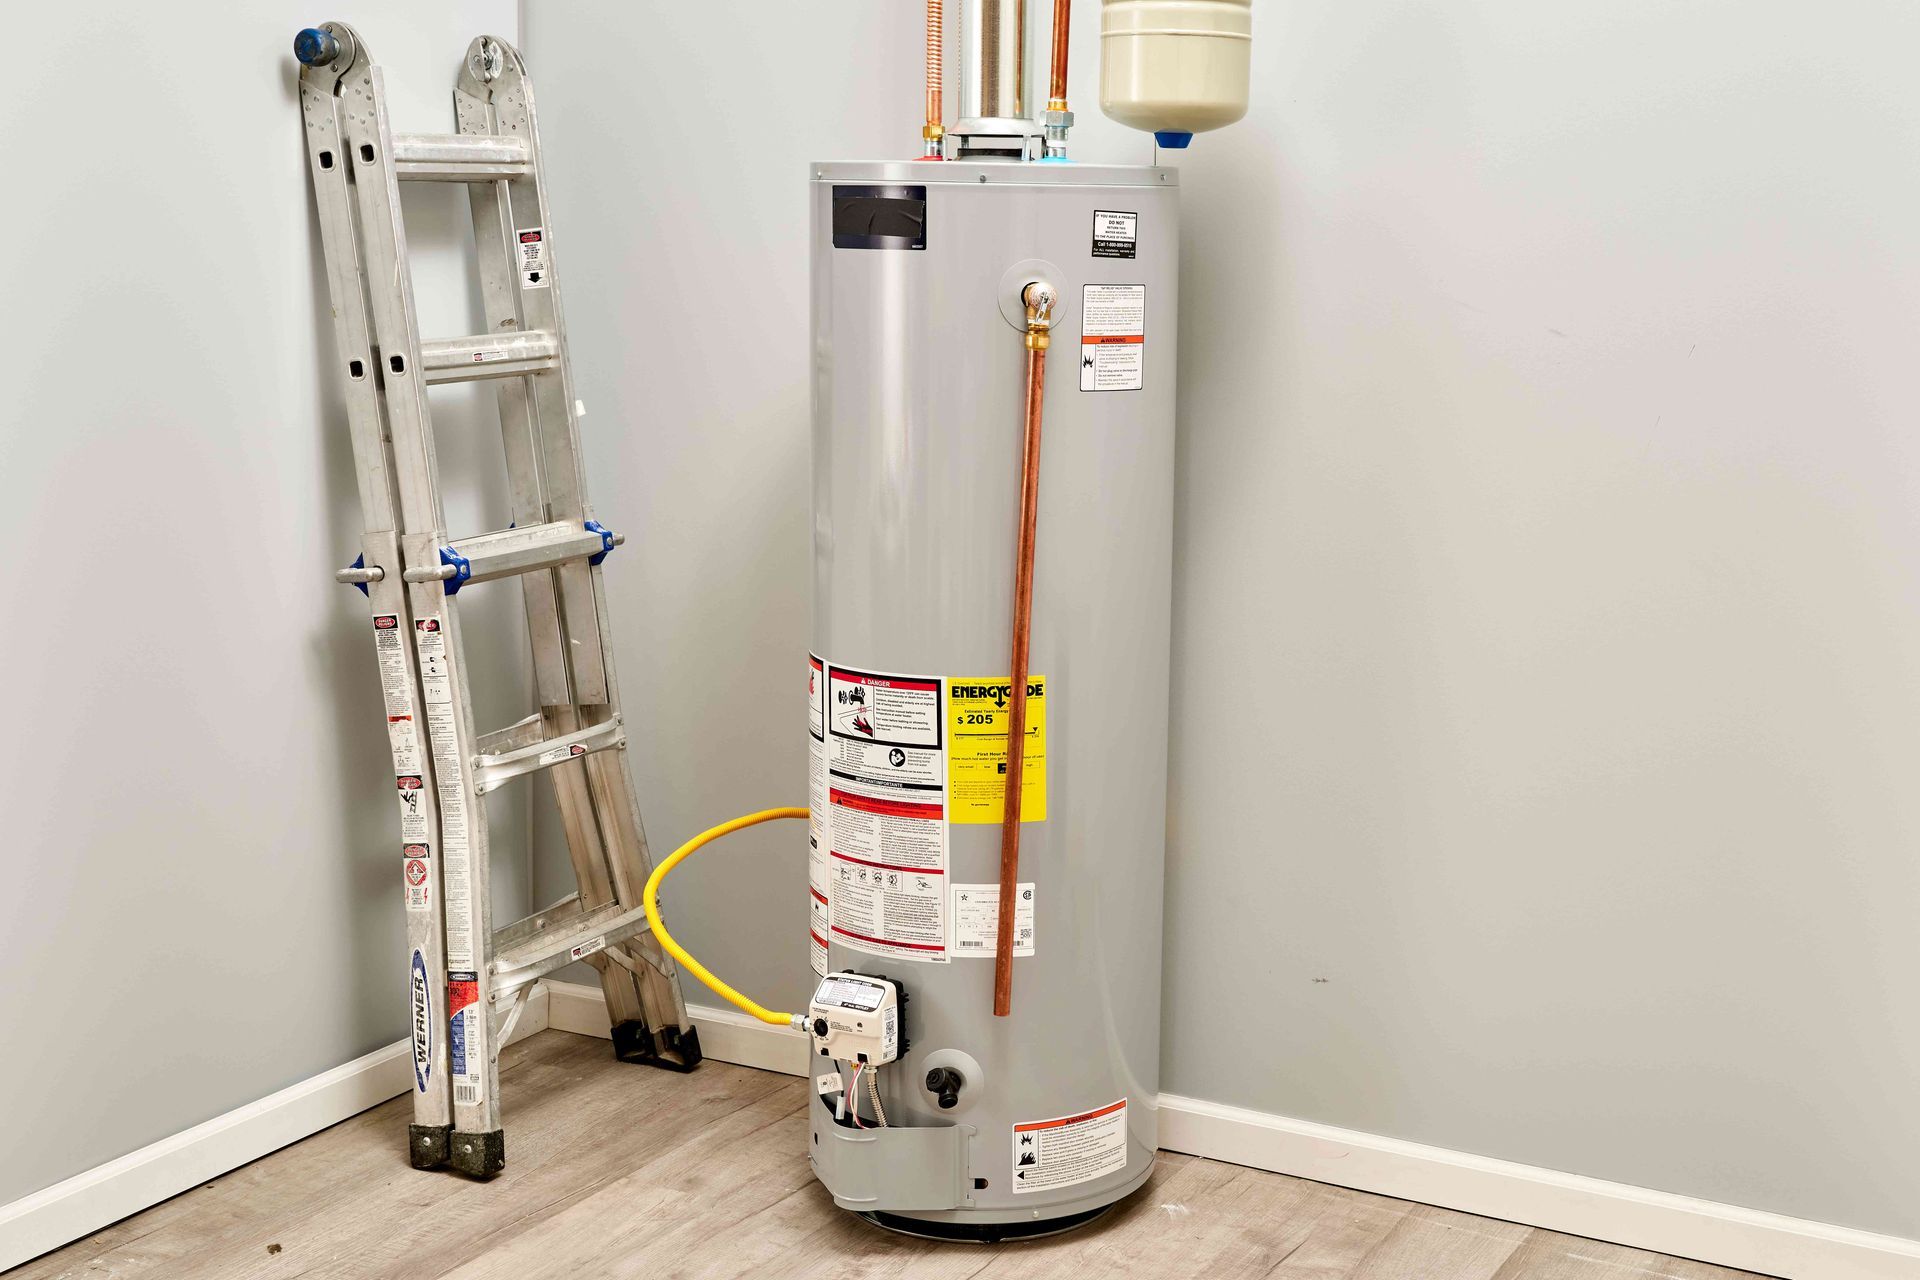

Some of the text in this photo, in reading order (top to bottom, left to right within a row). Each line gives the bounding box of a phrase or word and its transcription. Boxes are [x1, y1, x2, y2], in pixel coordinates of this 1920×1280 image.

[868, 679, 890, 687] DANGER
[952, 684, 1043, 698] ENERGYGDE
[967, 715, 993, 724] 205
[414, 978, 426, 1063] WERNER
